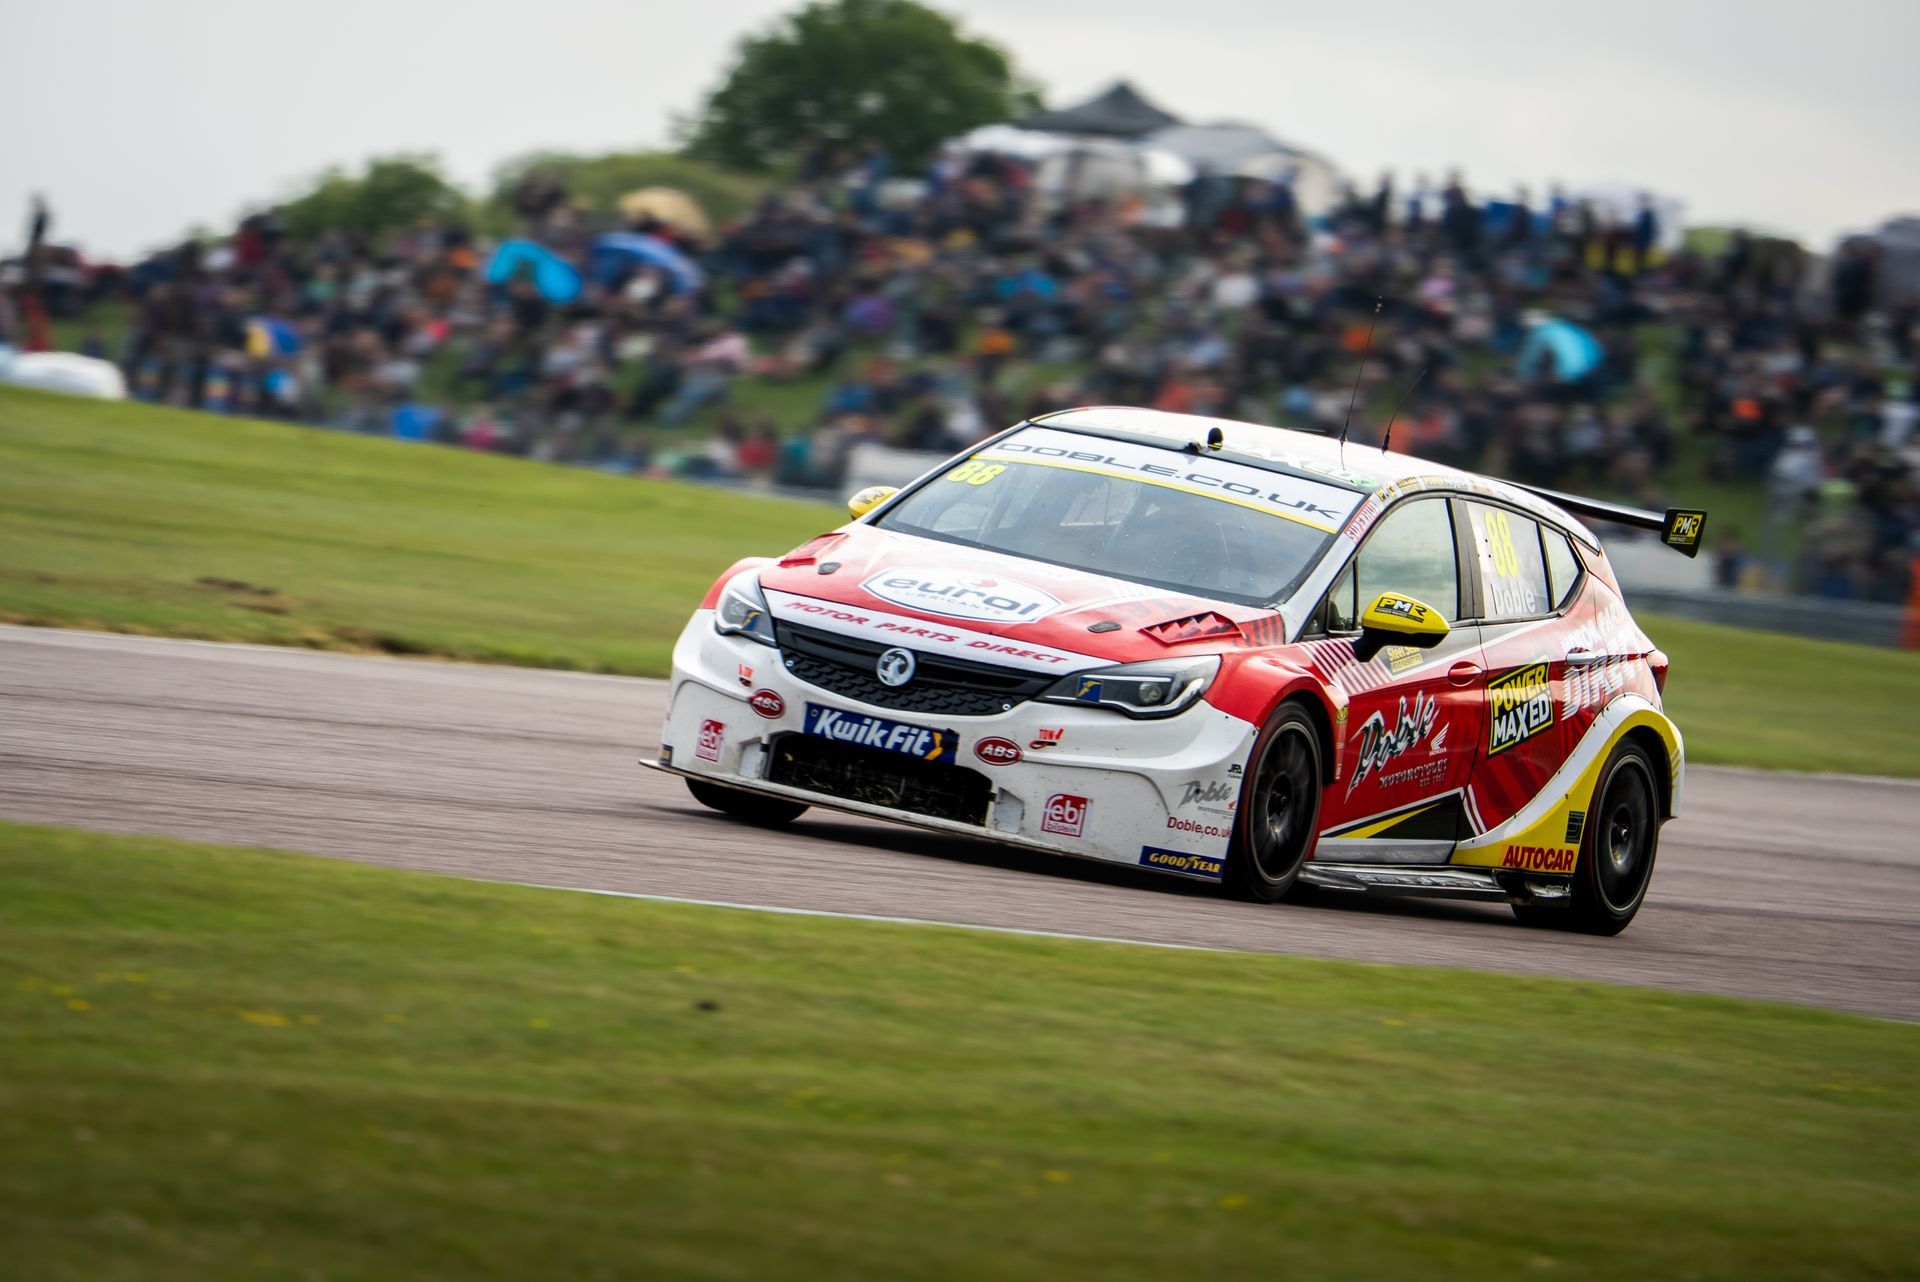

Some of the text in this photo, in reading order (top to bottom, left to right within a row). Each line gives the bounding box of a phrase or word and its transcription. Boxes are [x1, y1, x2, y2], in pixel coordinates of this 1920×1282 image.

[946, 461, 1006, 486] 88
[996, 443, 1343, 520] DOBLE.CO.UK
[1672, 516, 1701, 534] PMR
[1485, 511, 1518, 577] 88
[883, 578, 1041, 616] eurol
[1379, 598, 1427, 617] PMR
[1490, 579, 1536, 615] Doble
[784, 602, 1069, 664] MOTOR PARTS DIRECT
[753, 696, 781, 711] ABS
[1493, 665, 1546, 718] POWER
[1493, 693, 1550, 747] MAXED
[981, 743, 1017, 759] ABS
[1345, 690, 1441, 800] Doble
[1178, 780, 1234, 809] Doble
[1043, 795, 1087, 834] febi
[1046, 822, 1078, 834] bilstein
[1502, 845, 1575, 871] AUTOCAR
